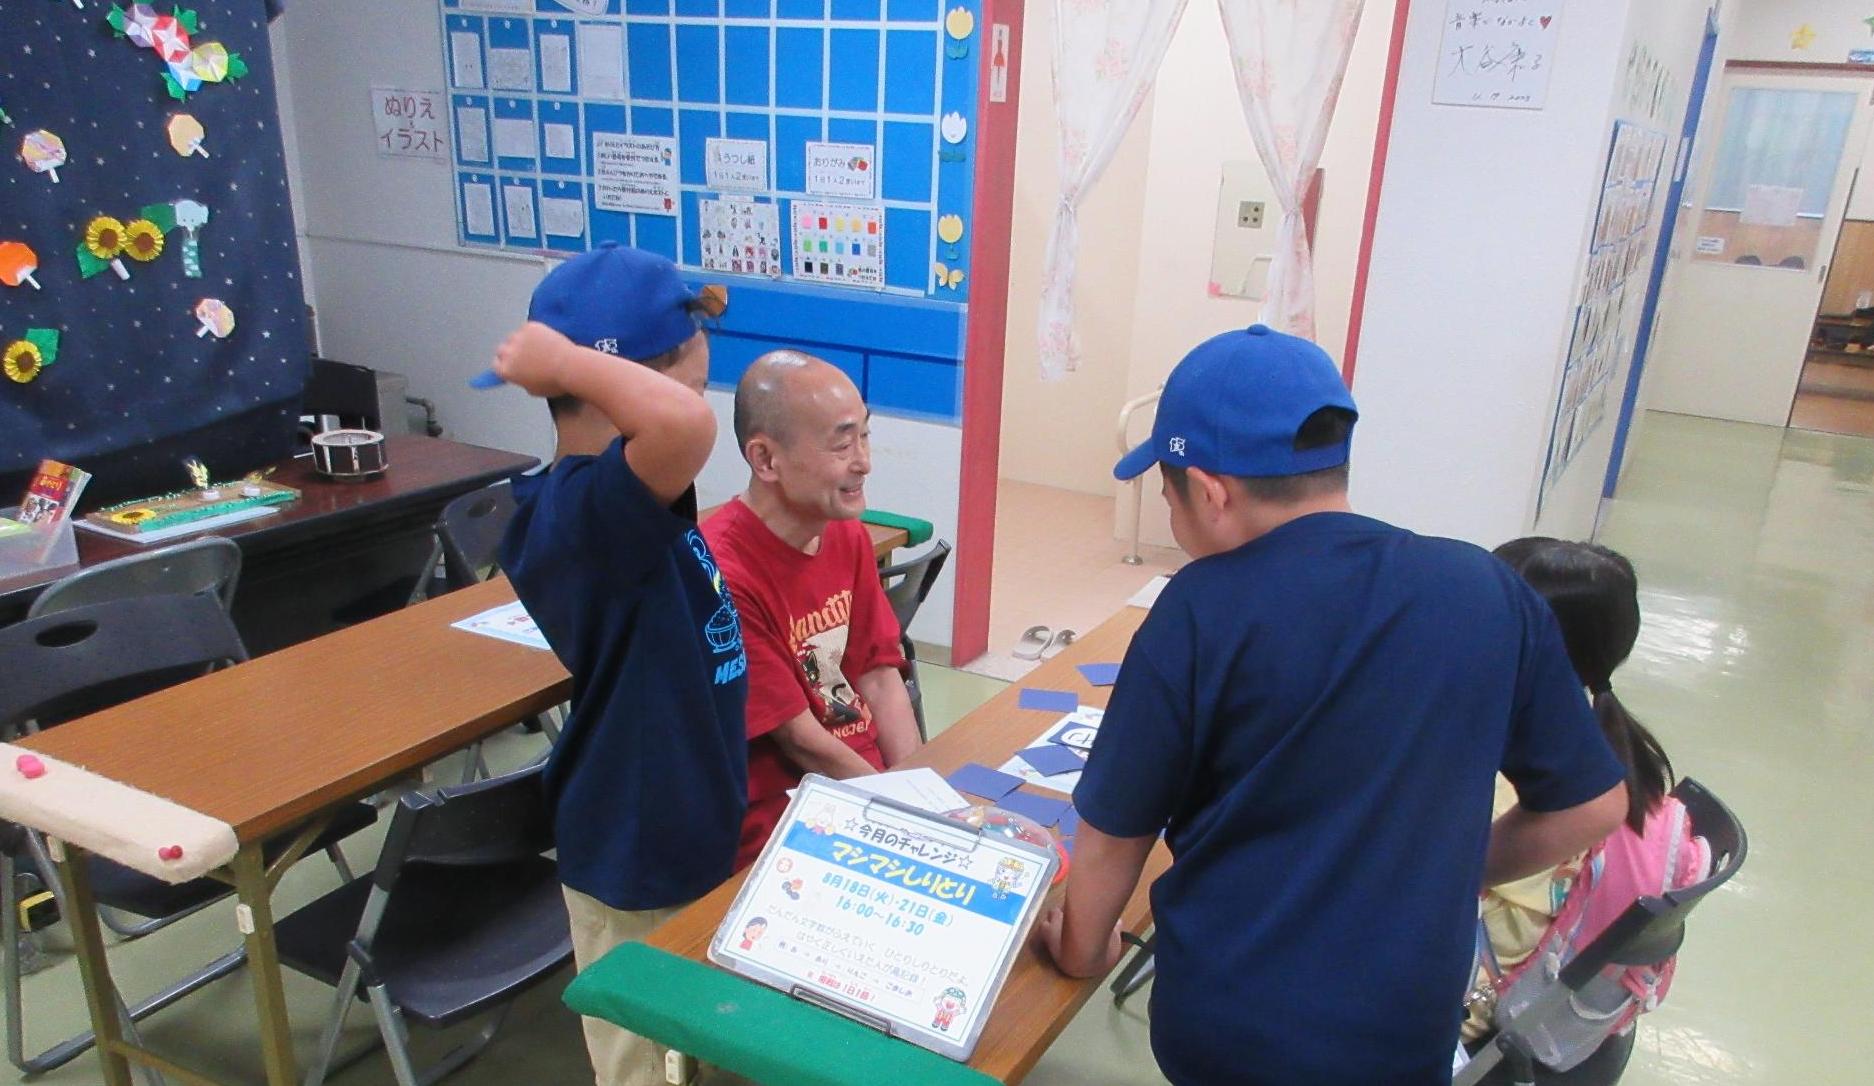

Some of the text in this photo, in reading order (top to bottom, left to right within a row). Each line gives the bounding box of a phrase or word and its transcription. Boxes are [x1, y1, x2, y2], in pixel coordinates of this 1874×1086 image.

[385, 96, 436, 120] ぬりえ
[380, 129, 445, 153] イラスト
[860, 823, 959, 865] 今月のチャレンジ
[832, 840, 977, 906] マシマシしりとり
